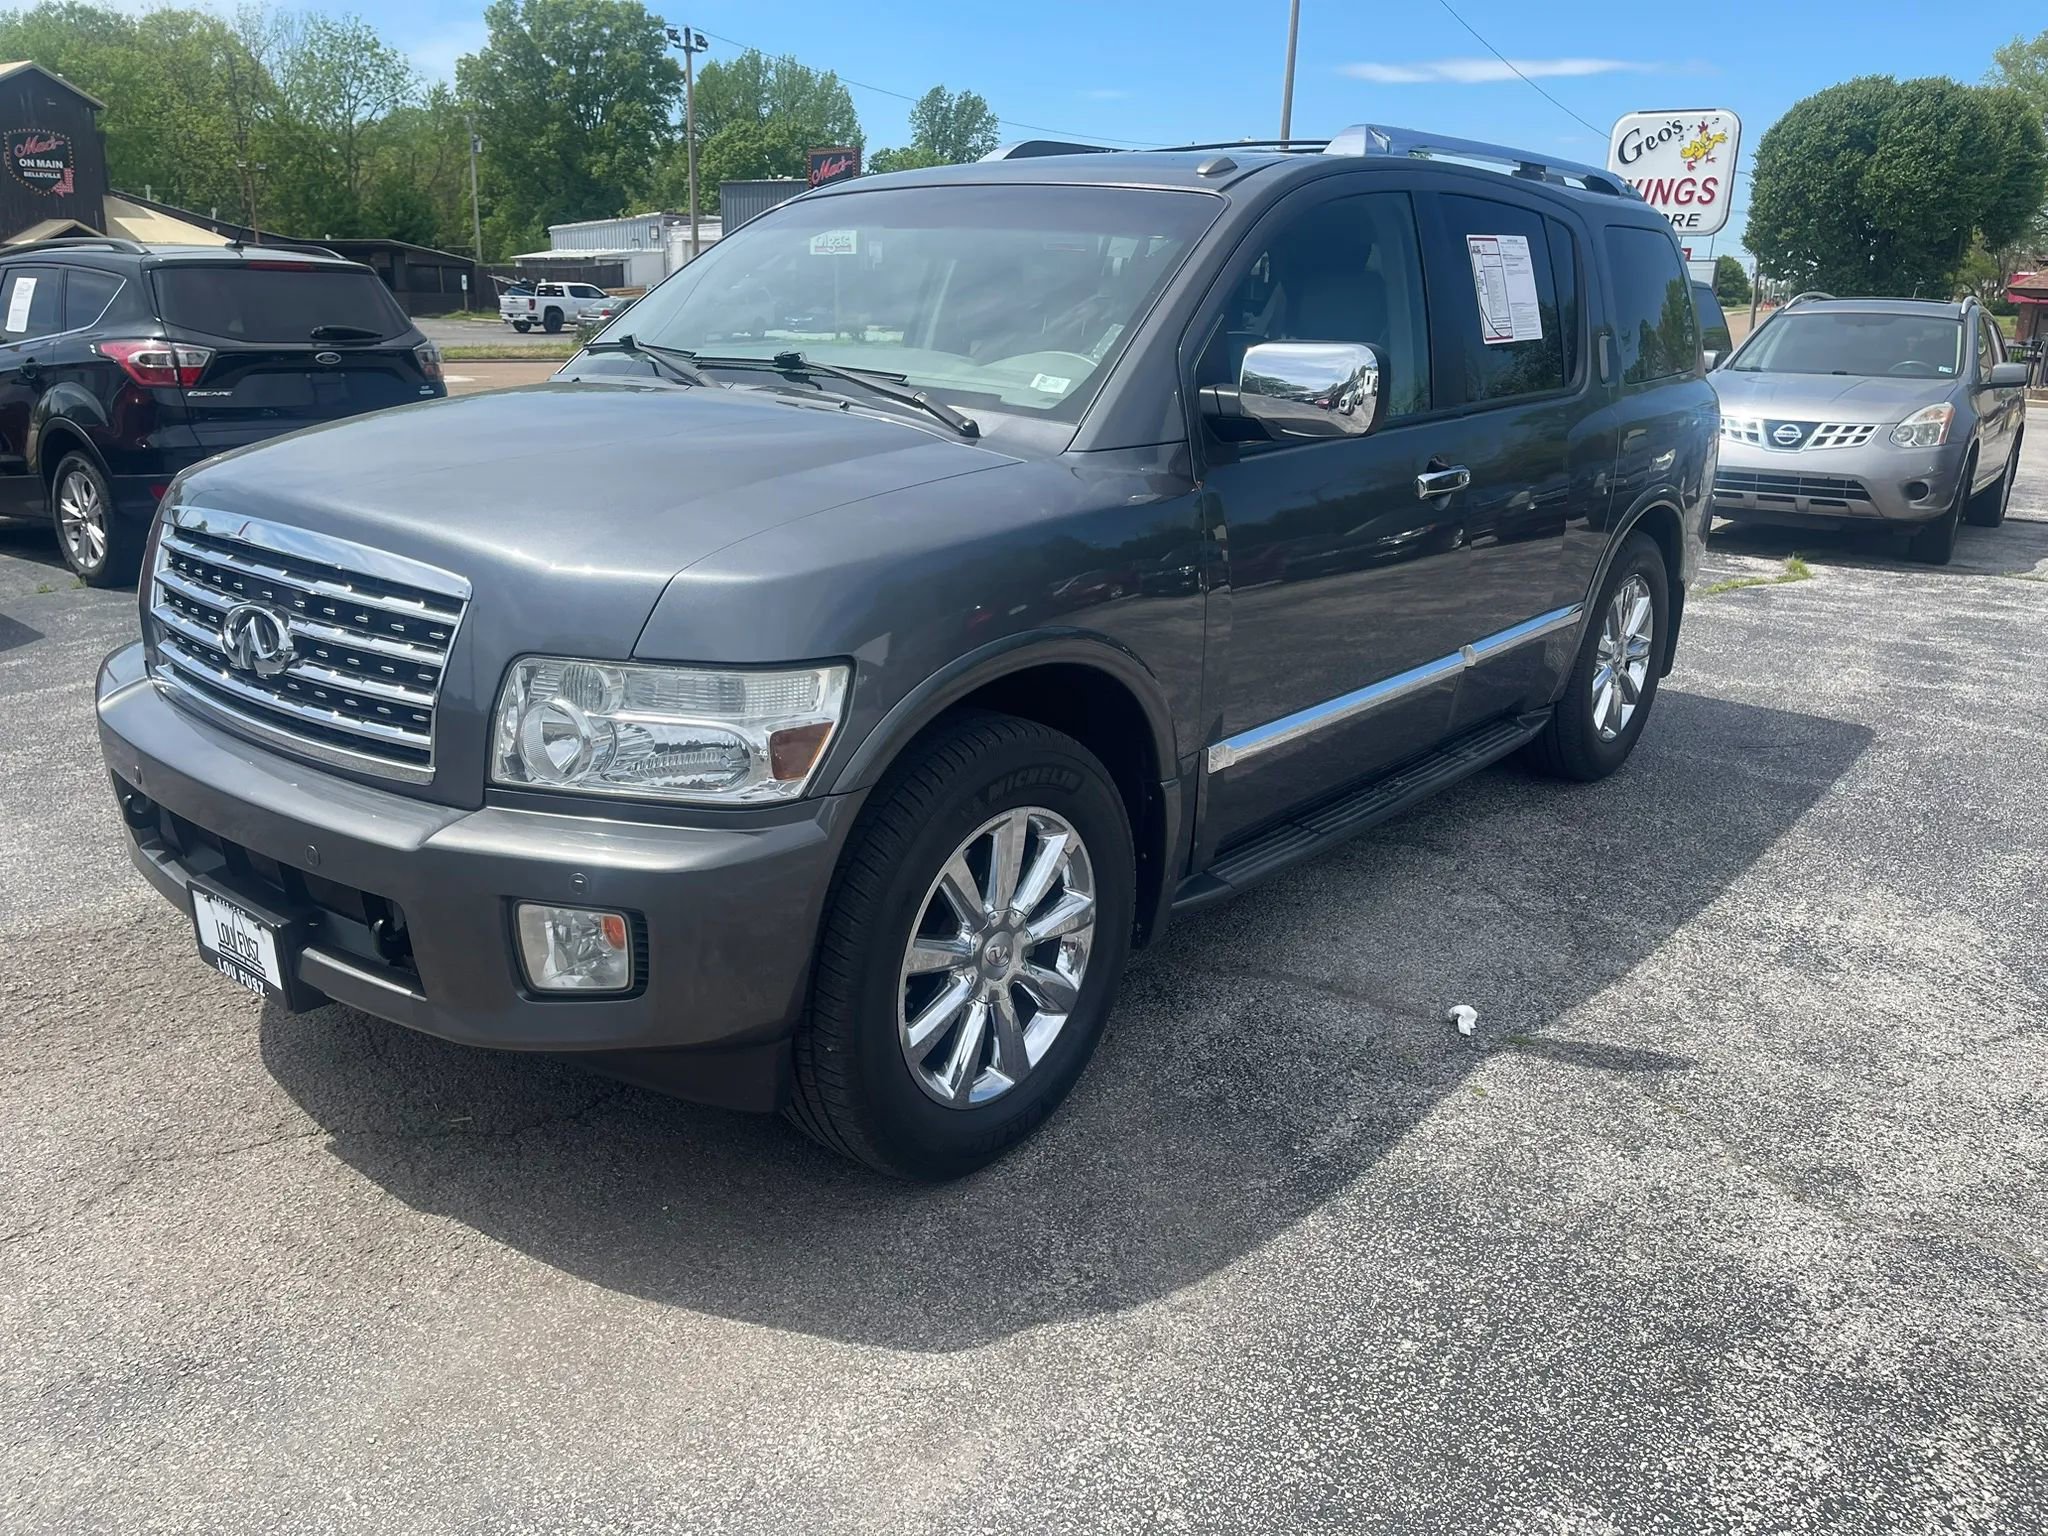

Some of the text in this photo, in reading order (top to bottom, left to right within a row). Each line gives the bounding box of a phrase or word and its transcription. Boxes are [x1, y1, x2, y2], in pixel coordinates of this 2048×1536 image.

[1618, 119, 1684, 165] Geo's
[19, 159, 64, 169] ON MAIN
[23, 171, 61, 179] BELLEVILLE
[1663, 213, 1701, 228] RE
[988, 767, 1080, 802] MICHELIN
[216, 919, 236, 949] LOU
[217, 957, 266, 998] LOU FUSZ
